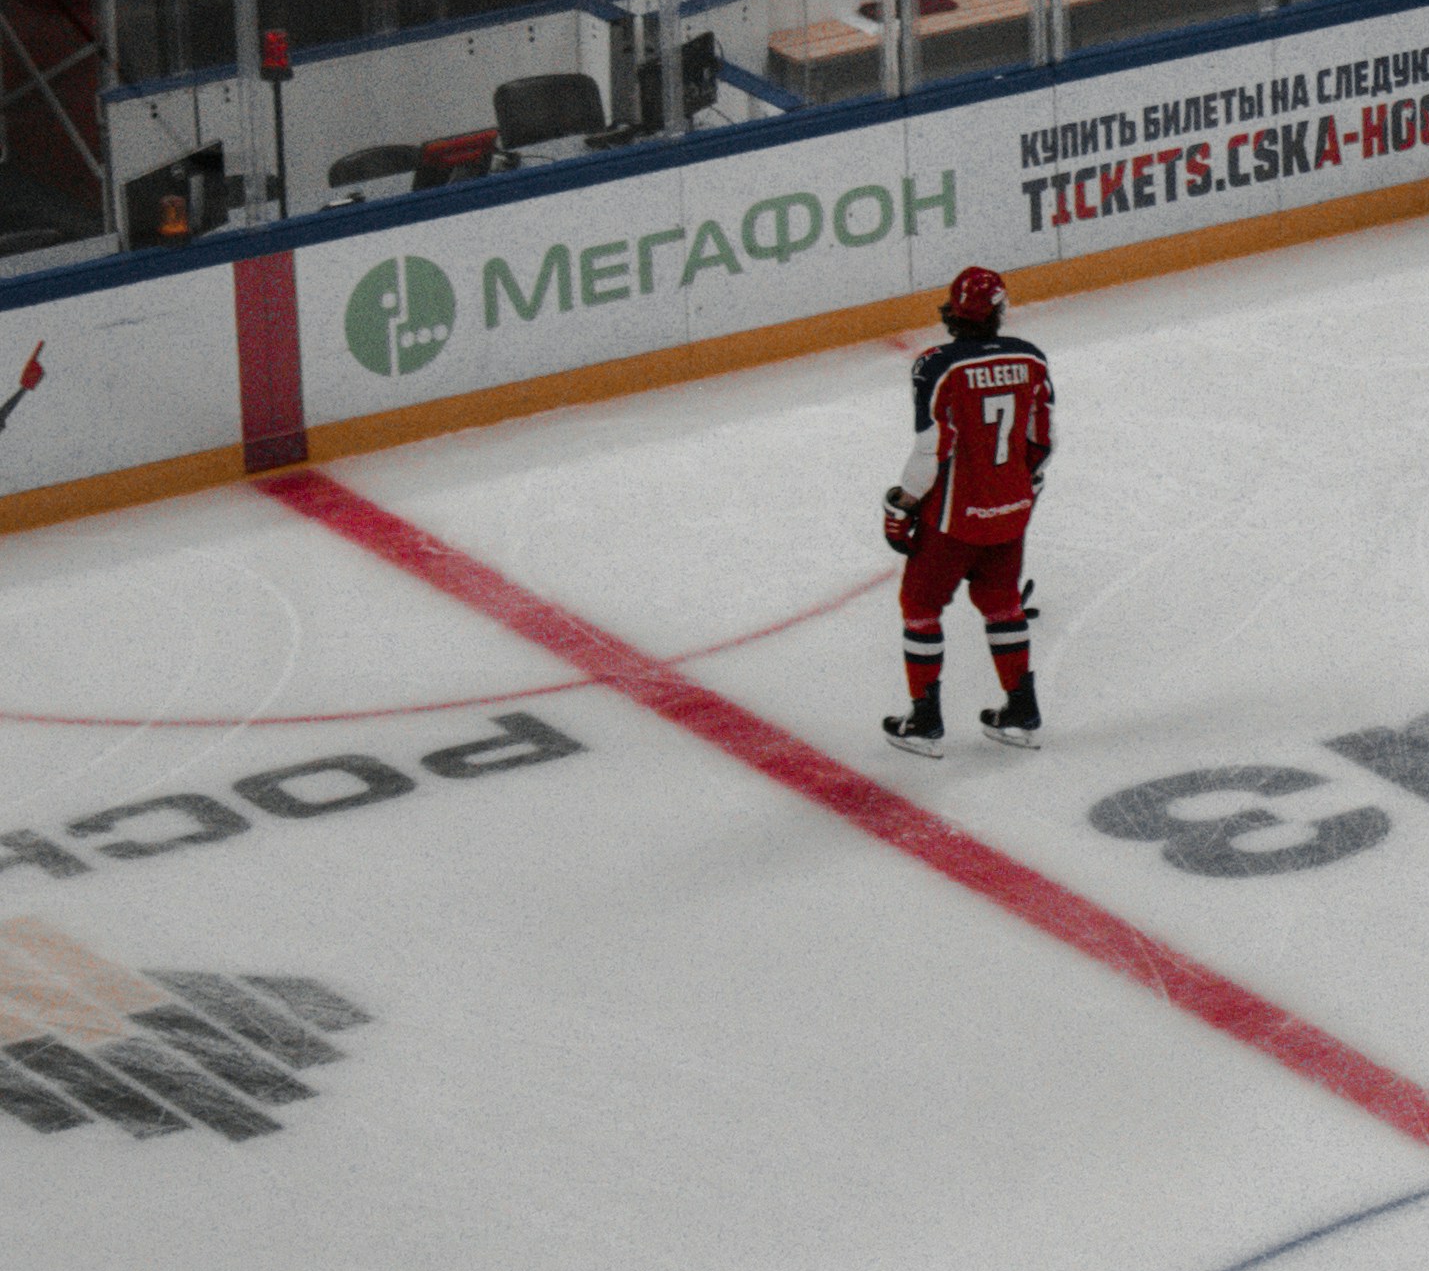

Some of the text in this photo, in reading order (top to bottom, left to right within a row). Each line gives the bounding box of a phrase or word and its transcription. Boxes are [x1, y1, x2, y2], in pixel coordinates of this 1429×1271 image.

[1020, 113, 1137, 170] КУПИТЬ
[1142, 83, 1266, 144] БИЛЕТЫ
[1269, 75, 1310, 114] НА
[481, 167, 958, 331] МЕГАФОН
[964, 362, 1030, 390] TELEGIN
[981, 391, 1017, 467] 7
